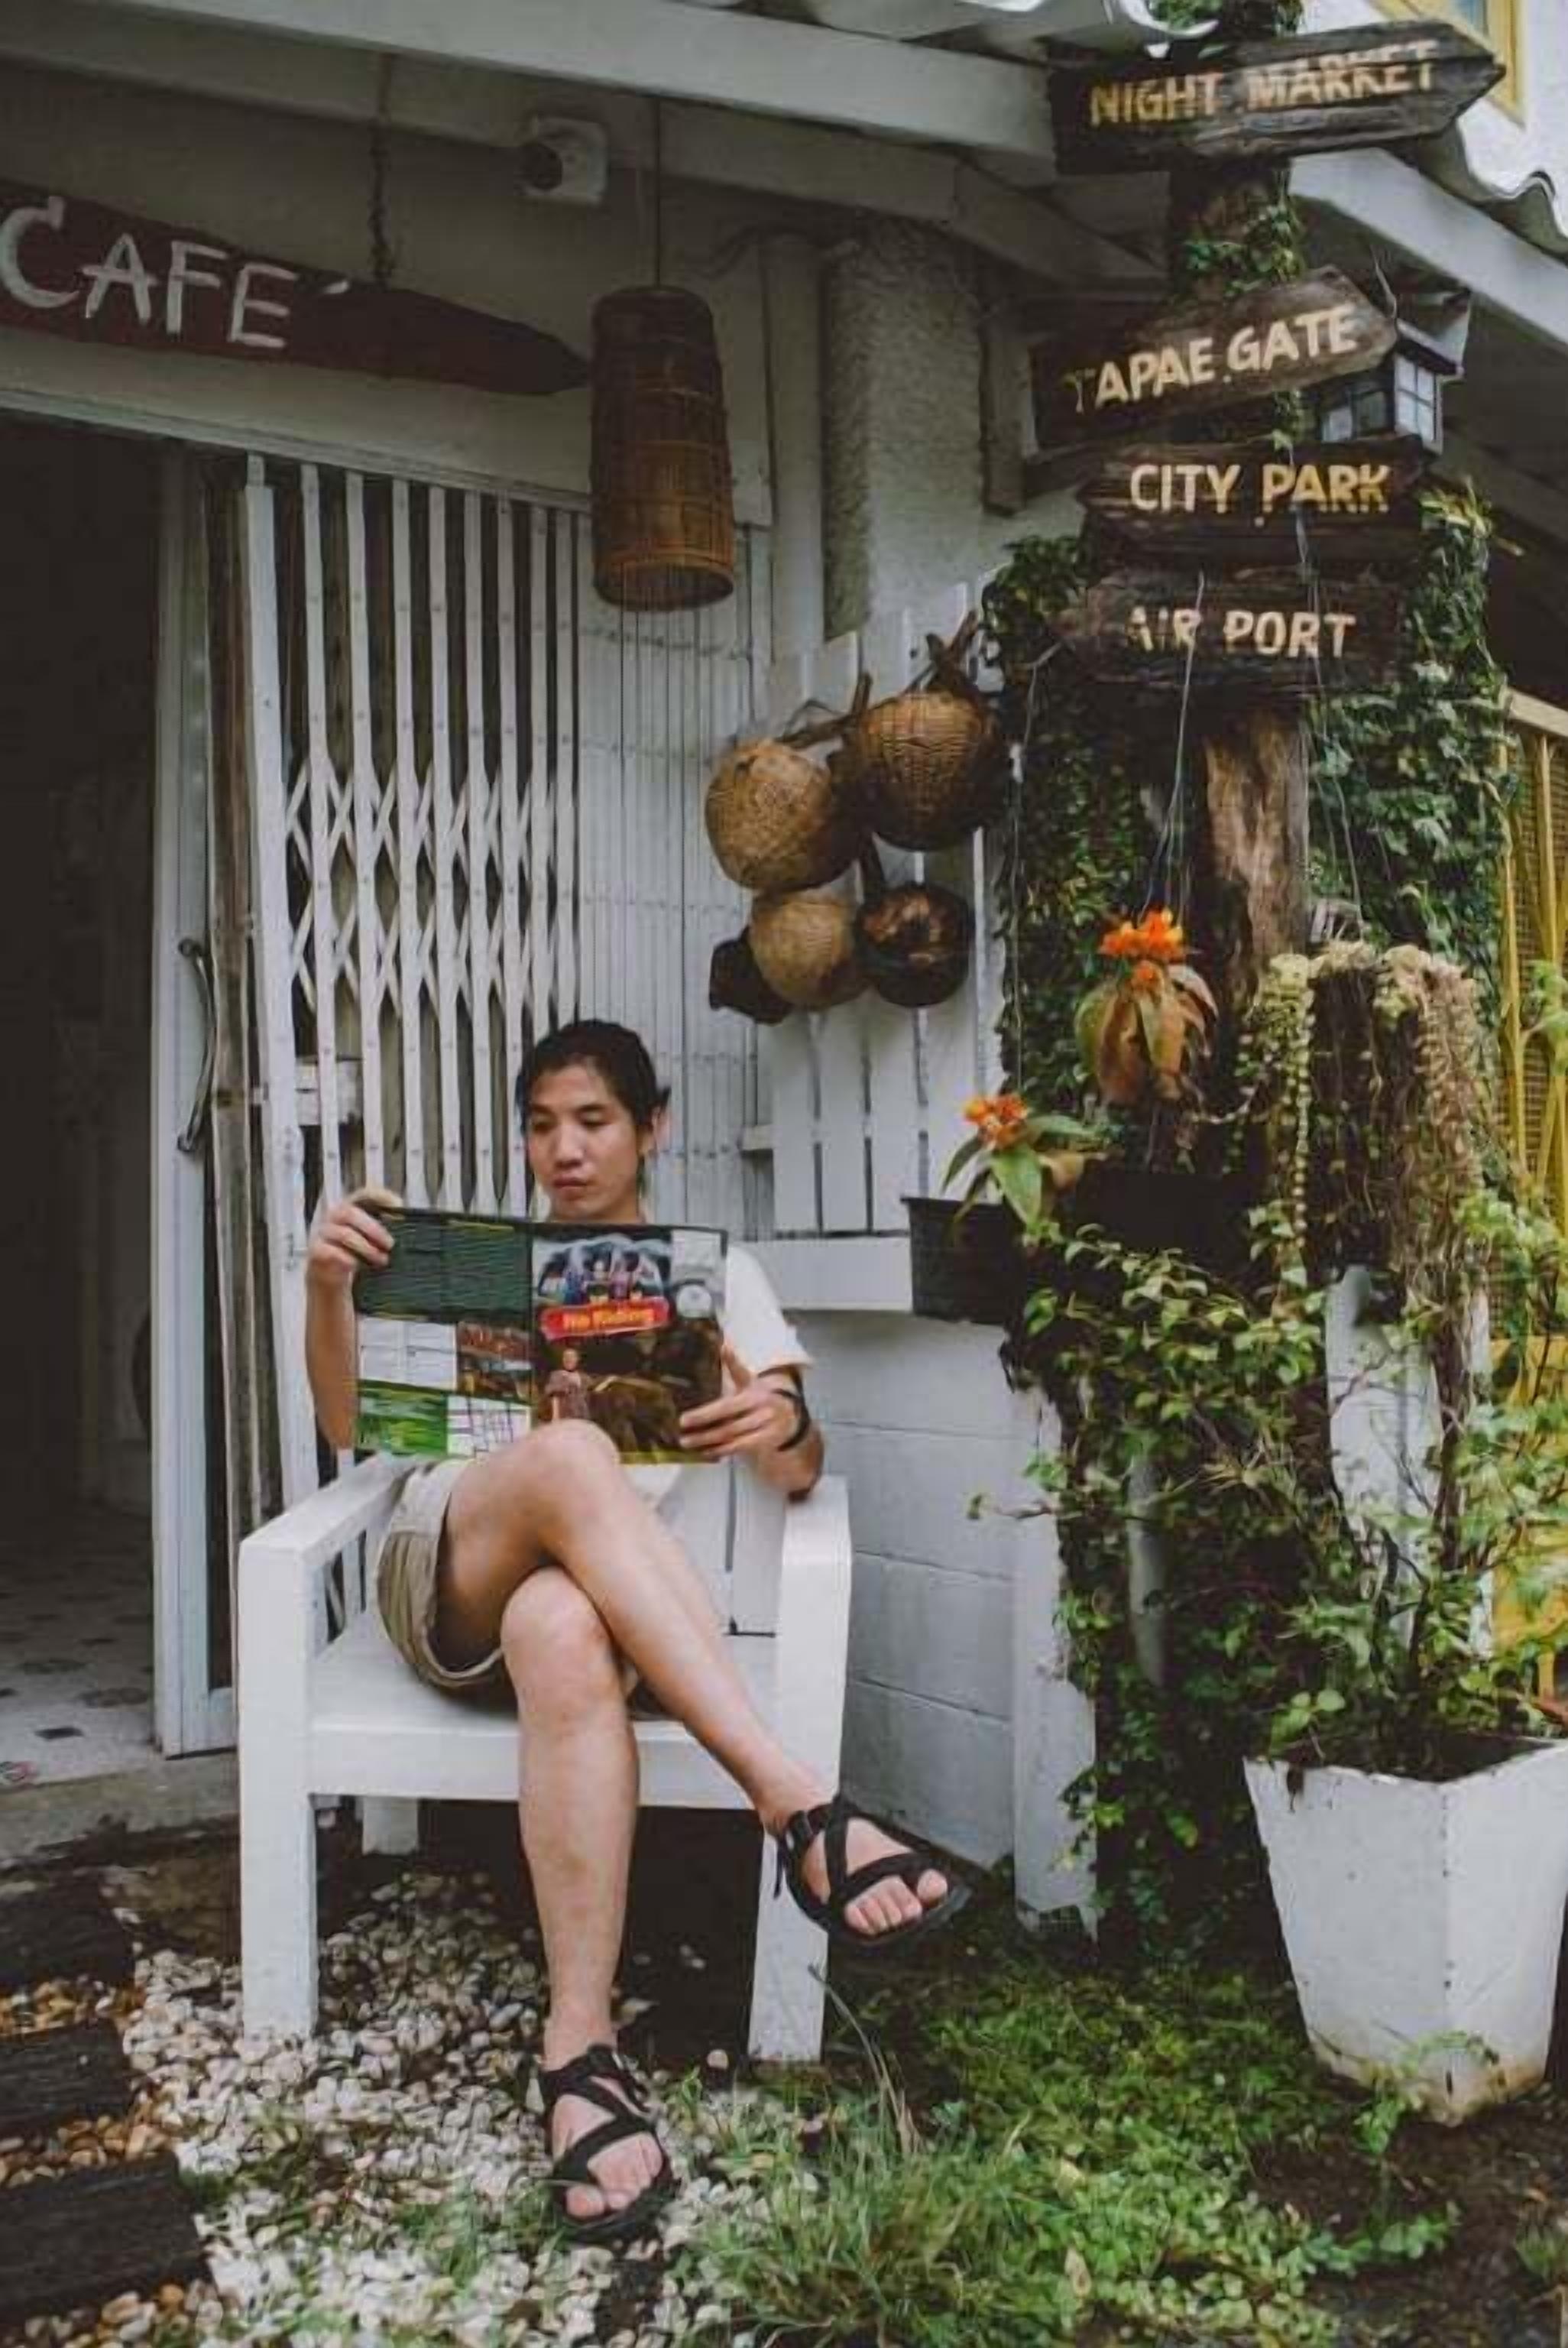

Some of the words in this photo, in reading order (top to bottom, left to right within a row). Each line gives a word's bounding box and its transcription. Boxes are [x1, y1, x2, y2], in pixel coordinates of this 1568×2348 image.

[1090, 72, 1224, 127] NIGHT
[1244, 39, 1440, 111] MARKET
[1227, 303, 1359, 373] GATE
[1129, 463, 1241, 514] CITY
[1262, 463, 1391, 514] PARK
[1126, 606, 1203, 651] AIR
[1223, 609, 1357, 658] PORT
